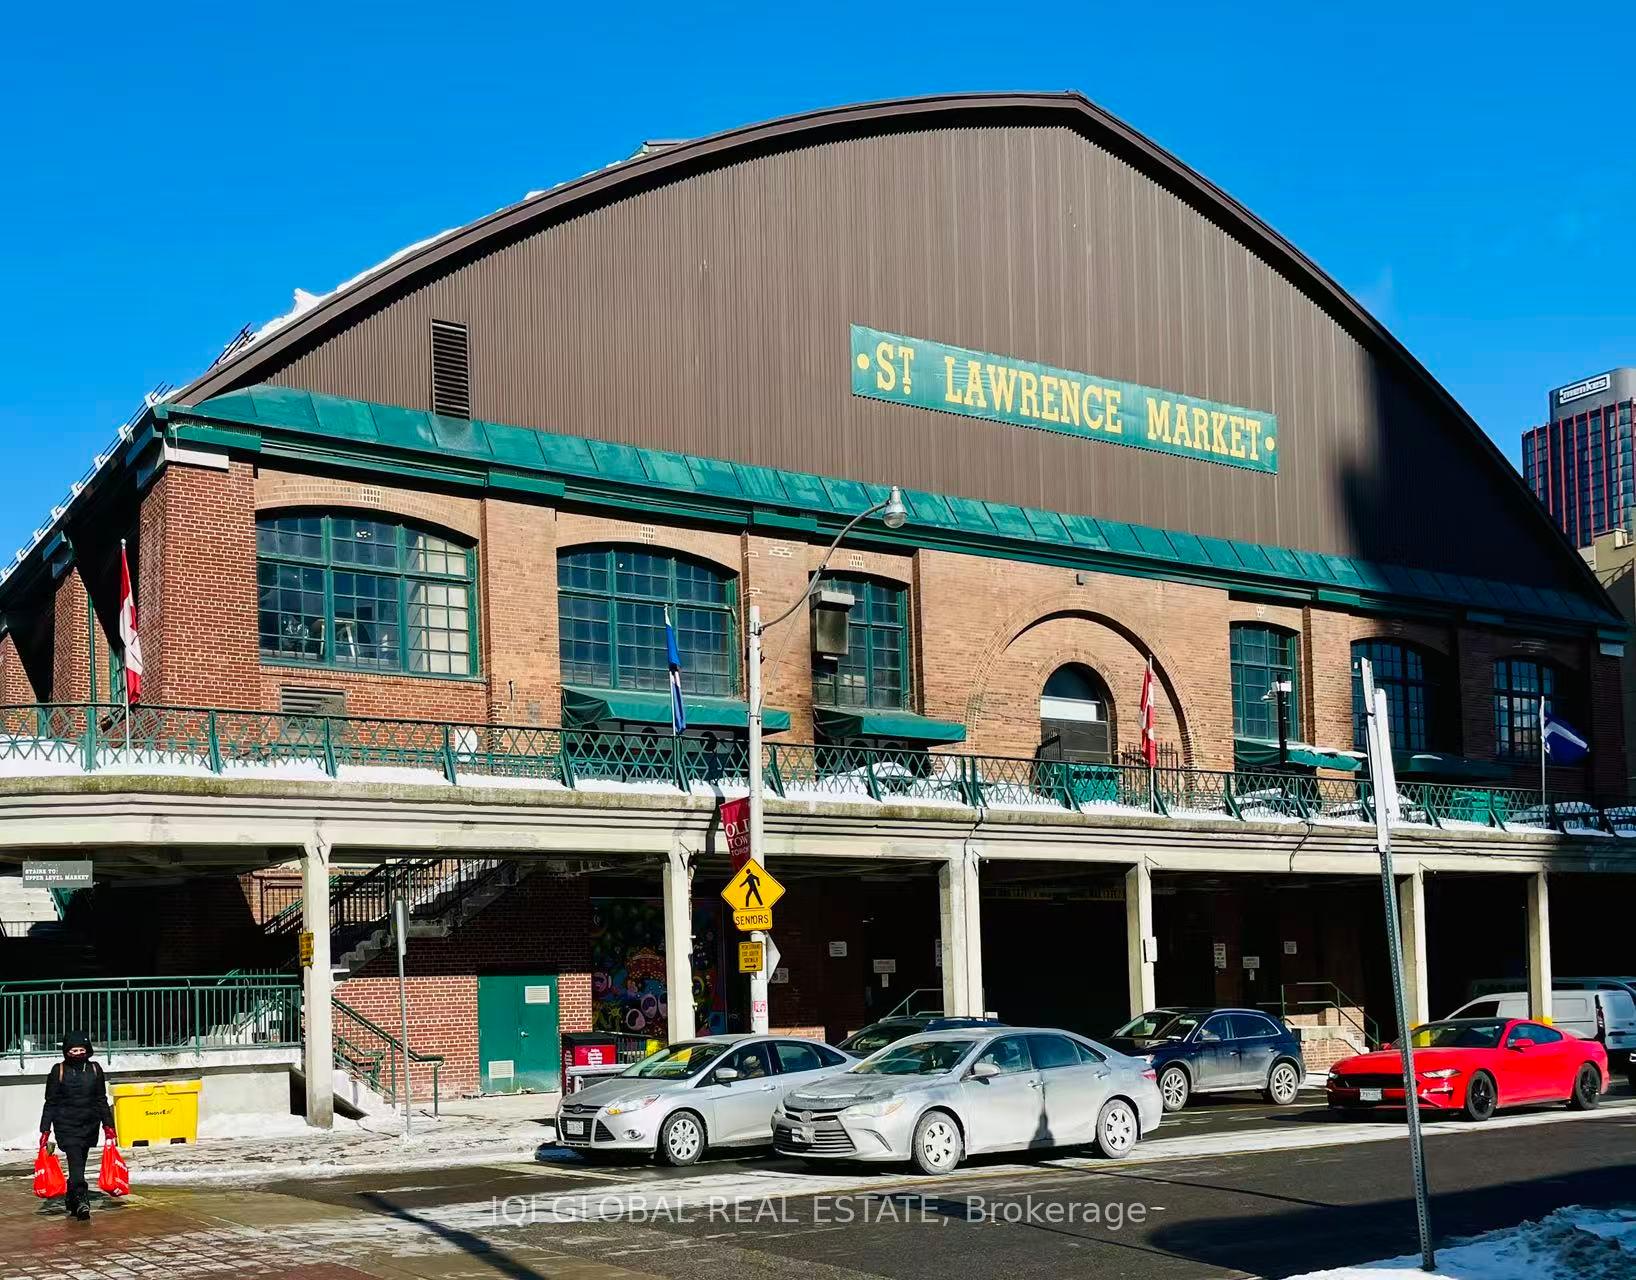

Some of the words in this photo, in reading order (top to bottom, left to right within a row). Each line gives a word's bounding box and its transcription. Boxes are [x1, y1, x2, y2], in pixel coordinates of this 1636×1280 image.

[944, 355, 1123, 434] LAWRENCE
[1146, 397, 1261, 461] MARKET
[728, 835, 749, 849] TOW
[735, 914, 769, 926] SENIORS
